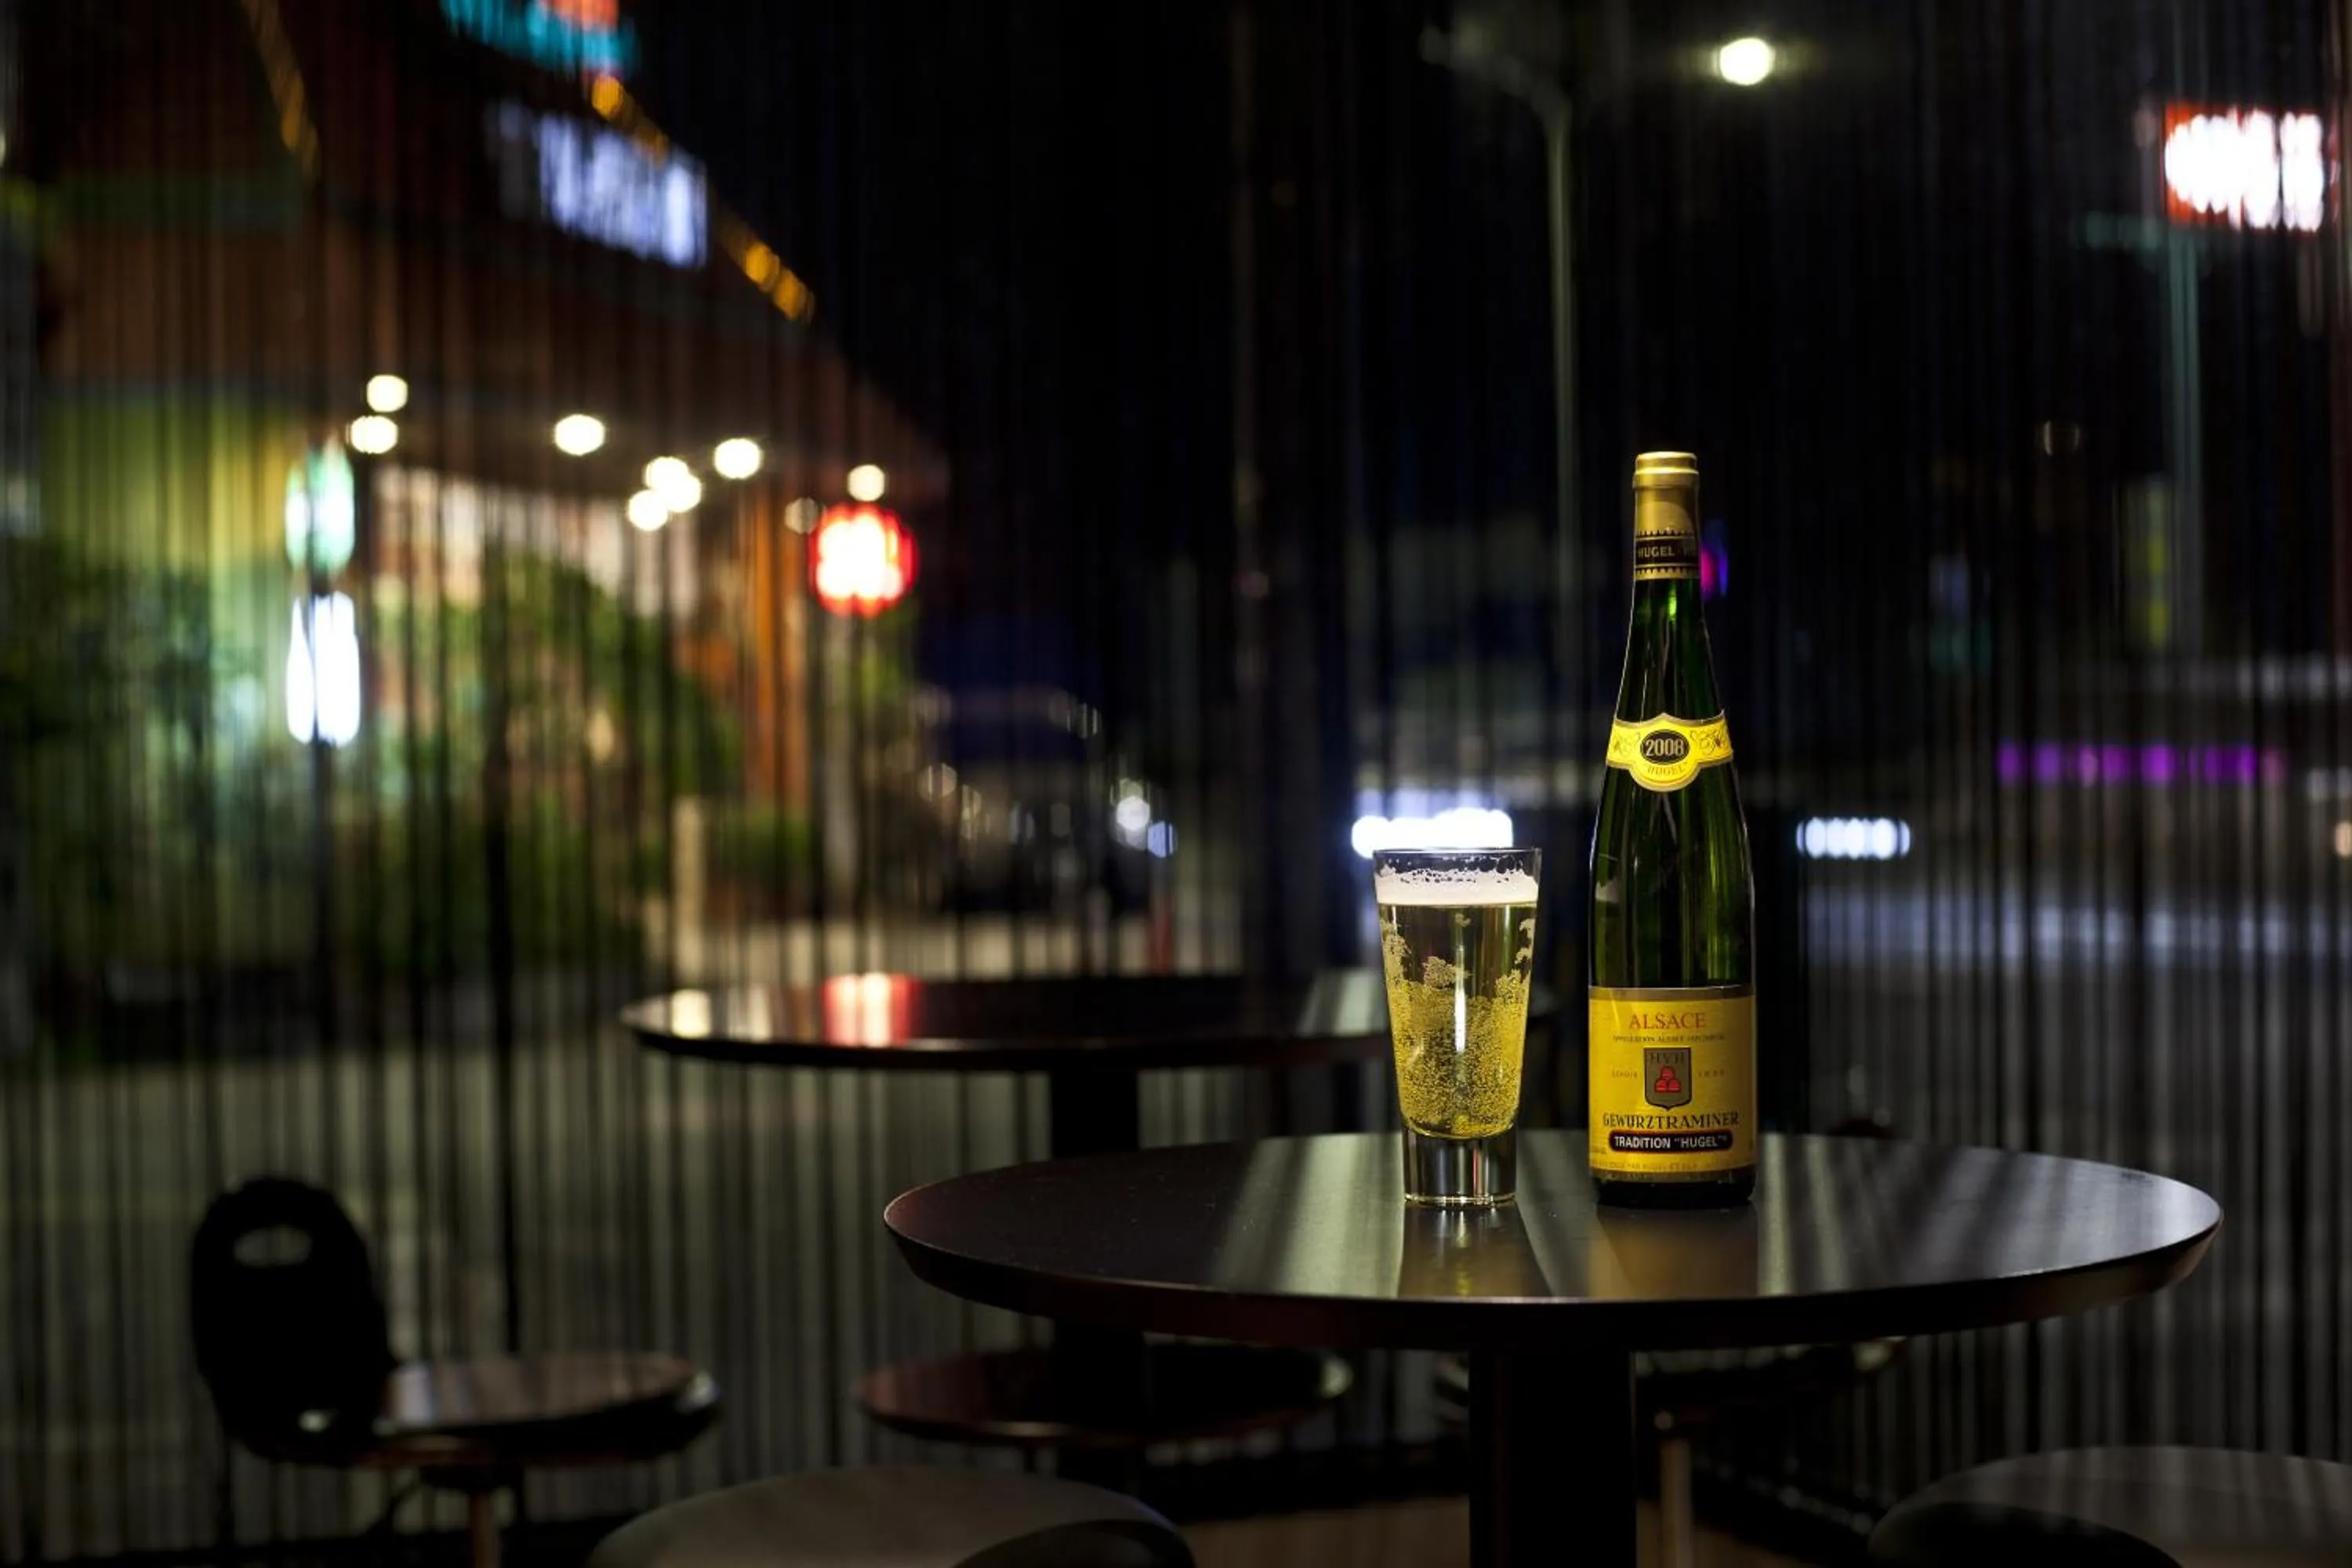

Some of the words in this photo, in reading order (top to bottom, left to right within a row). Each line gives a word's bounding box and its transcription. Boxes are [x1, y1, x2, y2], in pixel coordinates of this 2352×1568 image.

[1638, 545, 1675, 558] HUGEL
[1646, 738, 1685, 757] 2008
[1628, 1011, 1708, 1030] ALSACE
[1603, 1111, 1740, 1130] GEWURZTRAMINER
[1614, 1135, 1671, 1149] TRADITION
